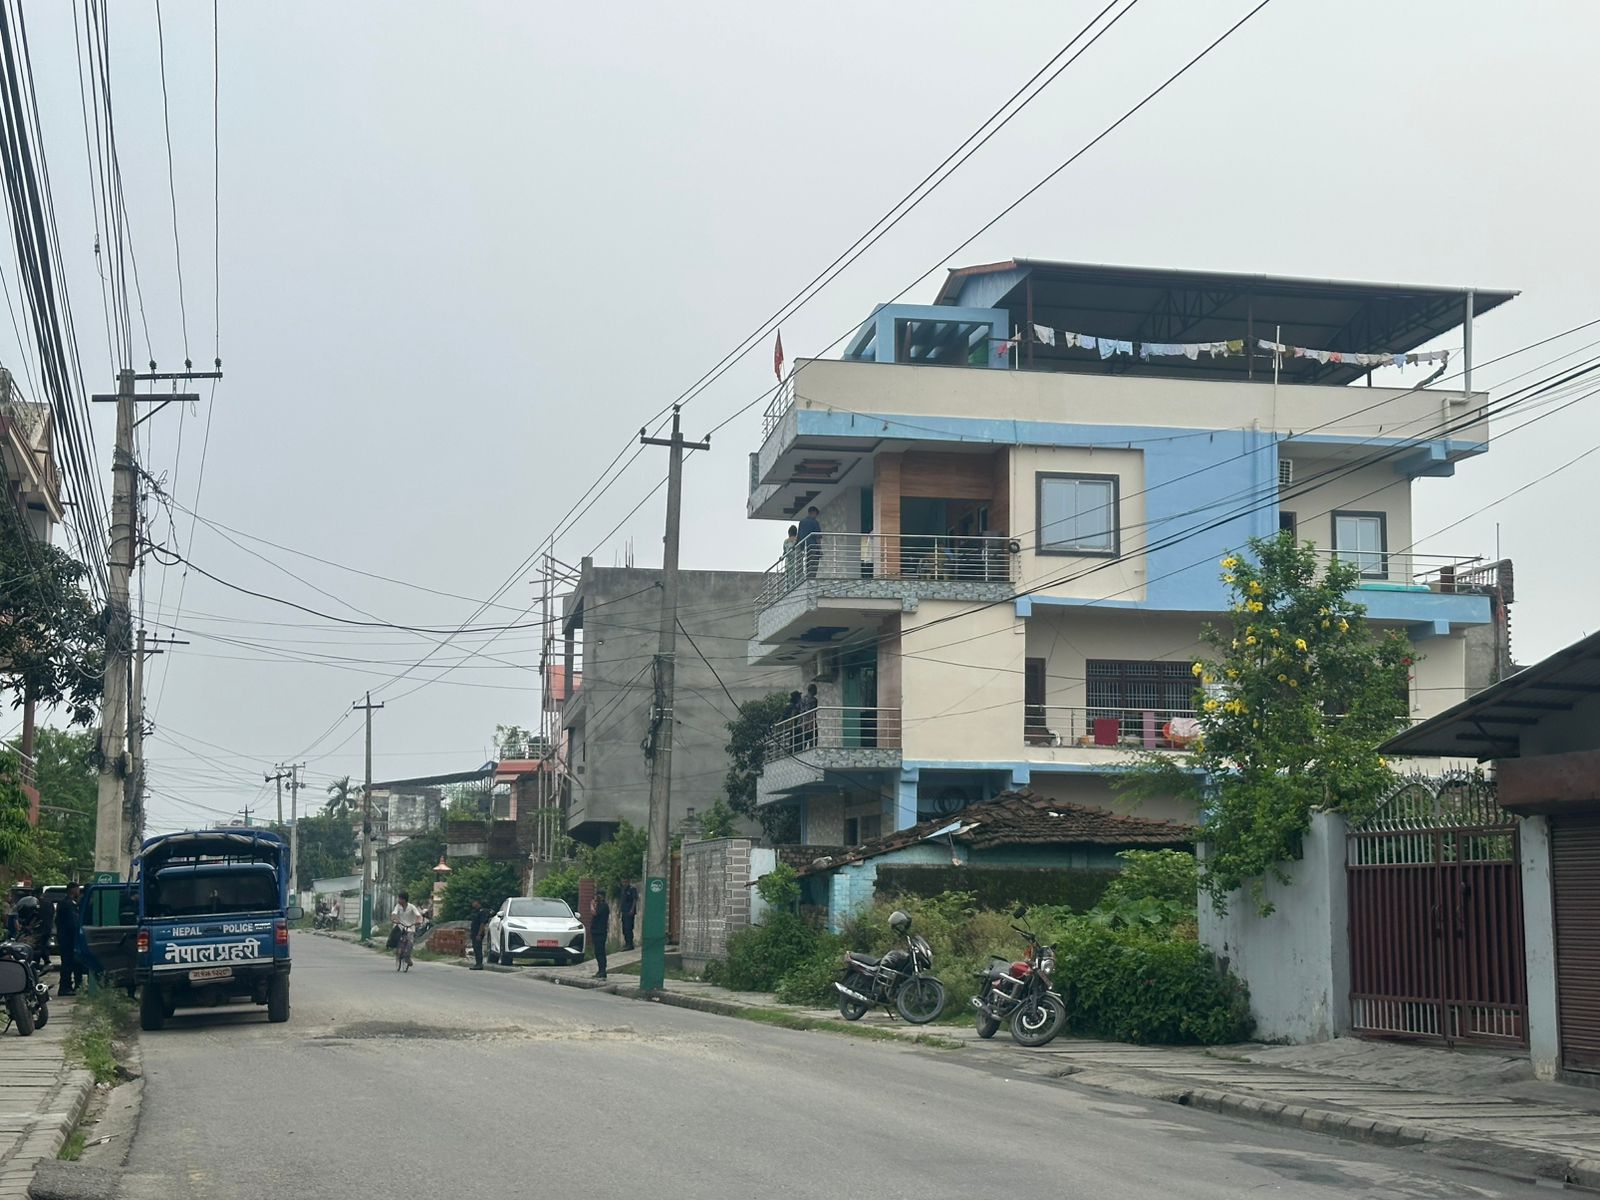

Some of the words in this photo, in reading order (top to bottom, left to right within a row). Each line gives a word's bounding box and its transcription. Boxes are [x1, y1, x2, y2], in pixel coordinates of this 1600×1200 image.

[172, 927, 202, 936] NEPAL
[223, 923, 253, 933] POLICE
[165, 943, 215, 963] नेपाल
[217, 938, 260, 960] प्रहरी
